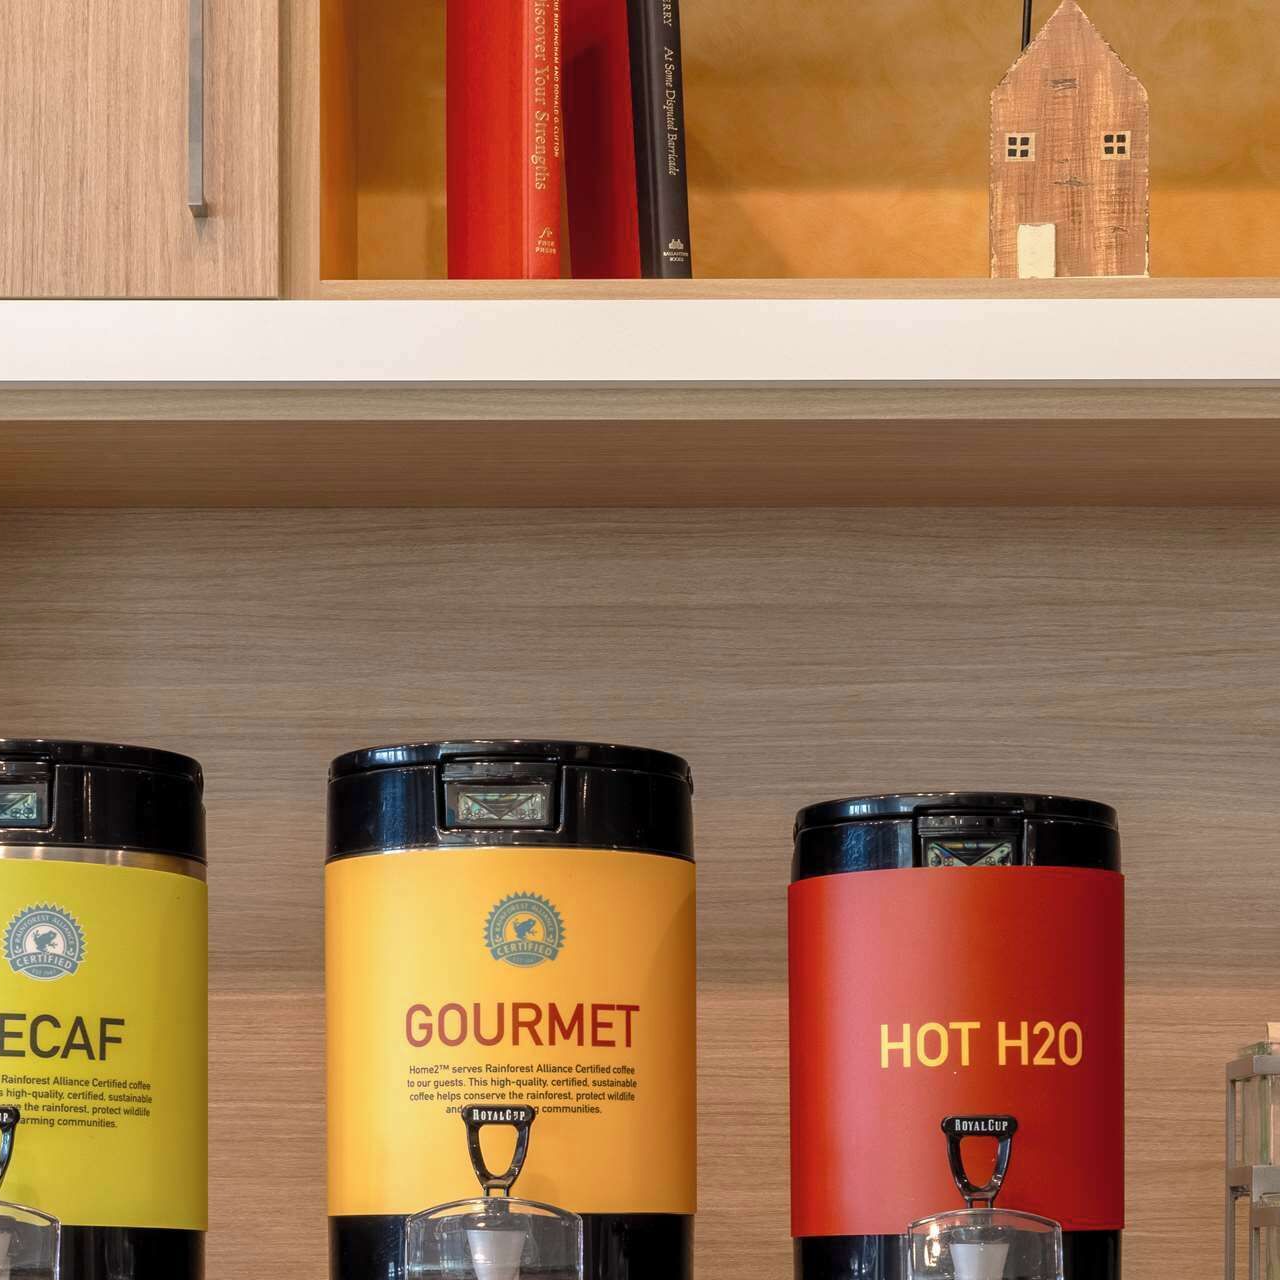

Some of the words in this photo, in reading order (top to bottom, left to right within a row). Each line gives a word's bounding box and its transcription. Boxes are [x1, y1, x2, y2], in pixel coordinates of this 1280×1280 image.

[663, 46, 674, 61] At
[664, 63, 675, 88] Some
[535, 65, 550, 108] Your
[663, 90, 677, 132] Disputed
[530, 110, 550, 191] Strengths
[667, 133, 680, 176] Barricade
[497, 942, 553, 956] CERTIFIED
[16, 955, 72, 969] CERTIFIED
[405, 1002, 640, 1048] GOURMET
[880, 1021, 981, 1068] HOT
[452, 1066, 483, 1074] serves
[485, 1064, 534, 1073] Rainforest
[536, 1064, 573, 1073] Alliance
[575, 1064, 611, 1074] Certified
[612, 1066, 635, 1075] coffee
[1, 1074, 50, 1085] Rainforest
[52, 1076, 90, 1087] Alliance
[91, 1078, 127, 1089] Certified
[128, 1081, 151, 1091] coffee
[407, 1079, 415, 1087] to
[433, 1079, 465, 1089] guests.
[468, 1077, 488, 1087] This
[551, 1077, 590, 1087] certified,
[591, 1078, 637, 1088] sustainable
[67, 1091, 106, 1101] certified,
[108, 1093, 152, 1104] sustainable
[409, 1092, 435, 1101] coffee
[436, 1091, 462, 1102] helps
[463, 1092, 506, 1100] conserve
[508, 1091, 524, 1099] the
[526, 1091, 573, 1100] rainforest,
[575, 1092, 606, 1102] protect
[607, 1092, 635, 1101] wildlife
[24, 1102, 39, 1111] the
[41, 1102, 89, 1113] rainforest,
[91, 1105, 121, 1116] protect
[123, 1108, 151, 1117] wildlife
[541, 1104, 602, 1114] communities.
[20, 1116, 55, 1127] arming
[57, 1117, 118, 1128] communities.
